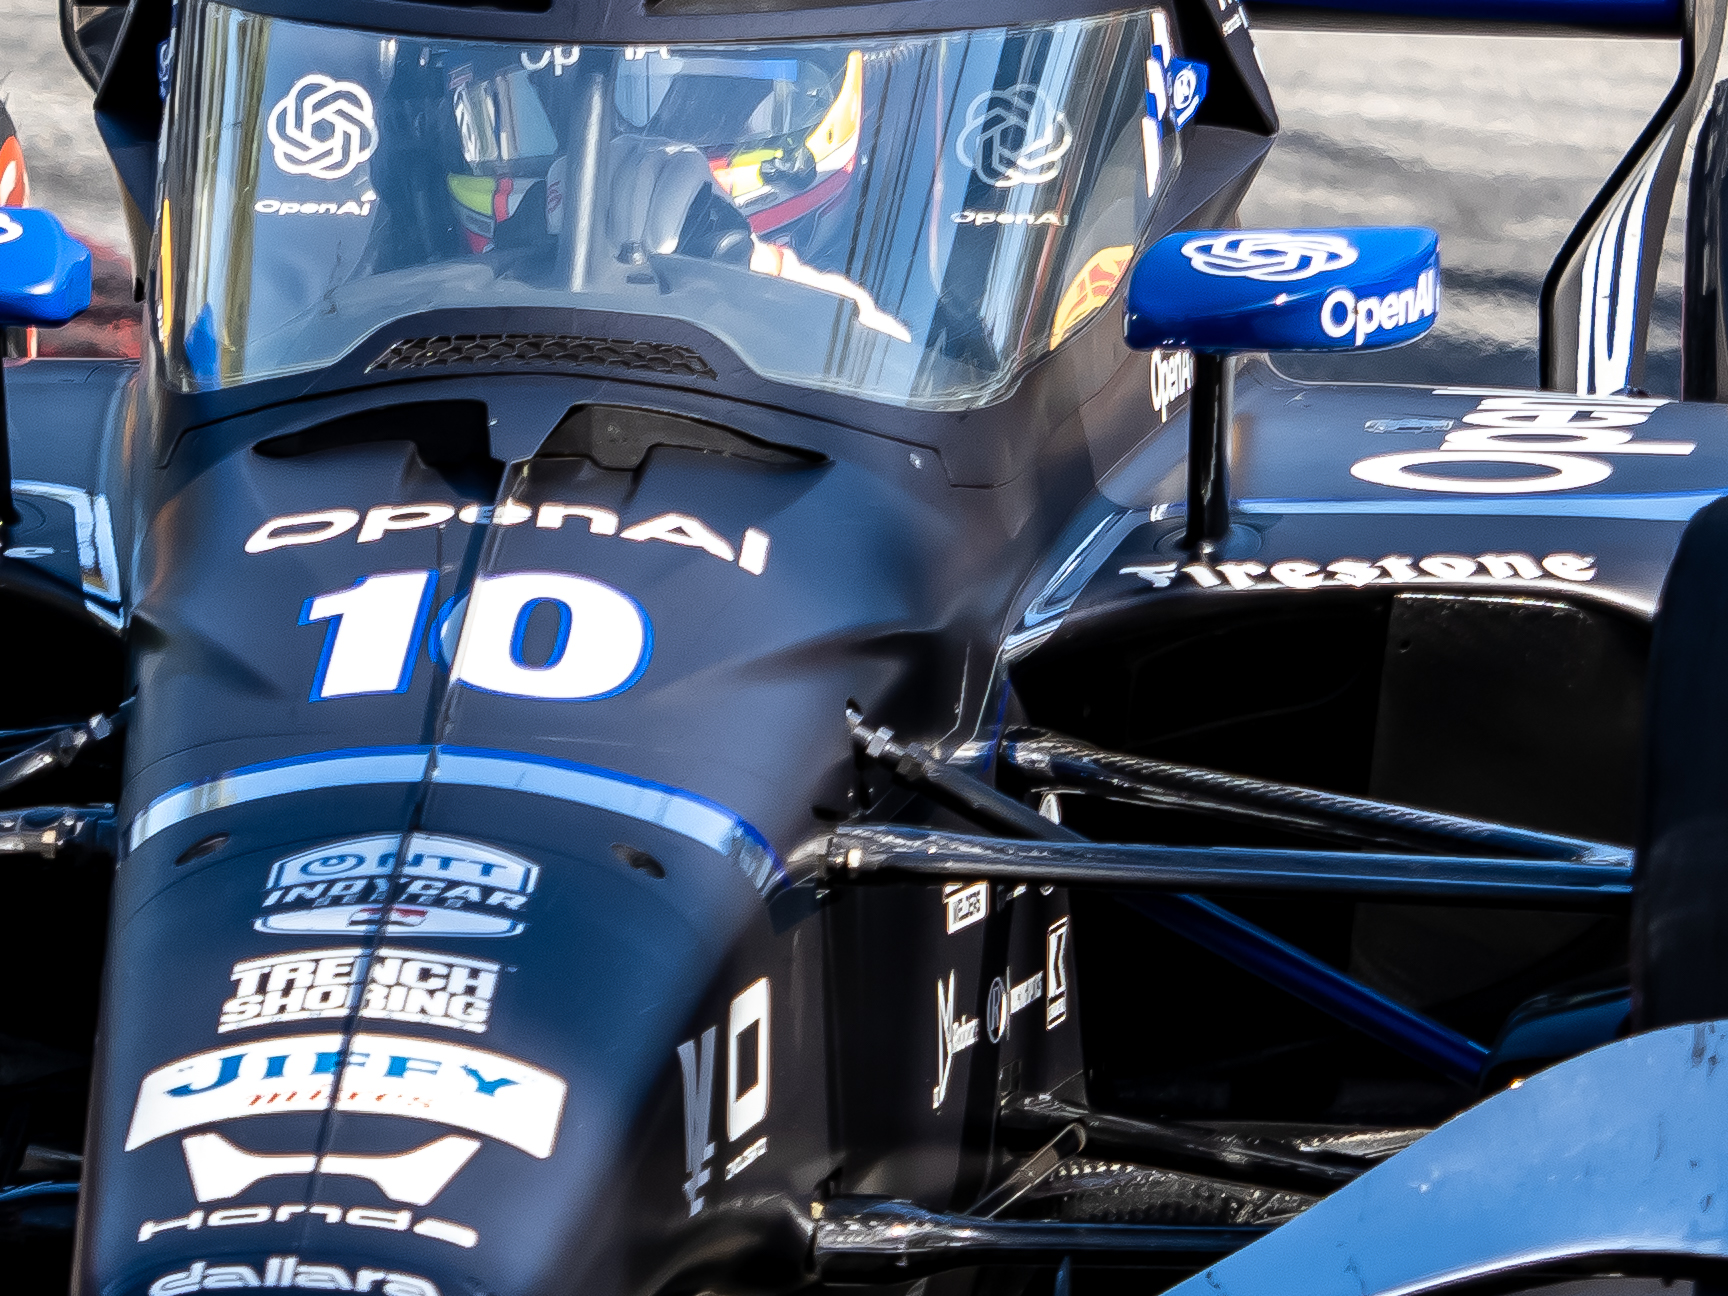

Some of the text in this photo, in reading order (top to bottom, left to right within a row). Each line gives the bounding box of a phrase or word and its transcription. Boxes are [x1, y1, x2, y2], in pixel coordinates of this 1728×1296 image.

[254, 190, 377, 217] OpenAI
[1321, 268, 1437, 346] OpenAI
[1151, 347, 1194, 424] OpenA
[244, 503, 770, 575] OpenAI
[297, 569, 654, 702] 10
[231, 956, 498, 1001] TRENCH
[165, 1051, 520, 1098] JIFFY
